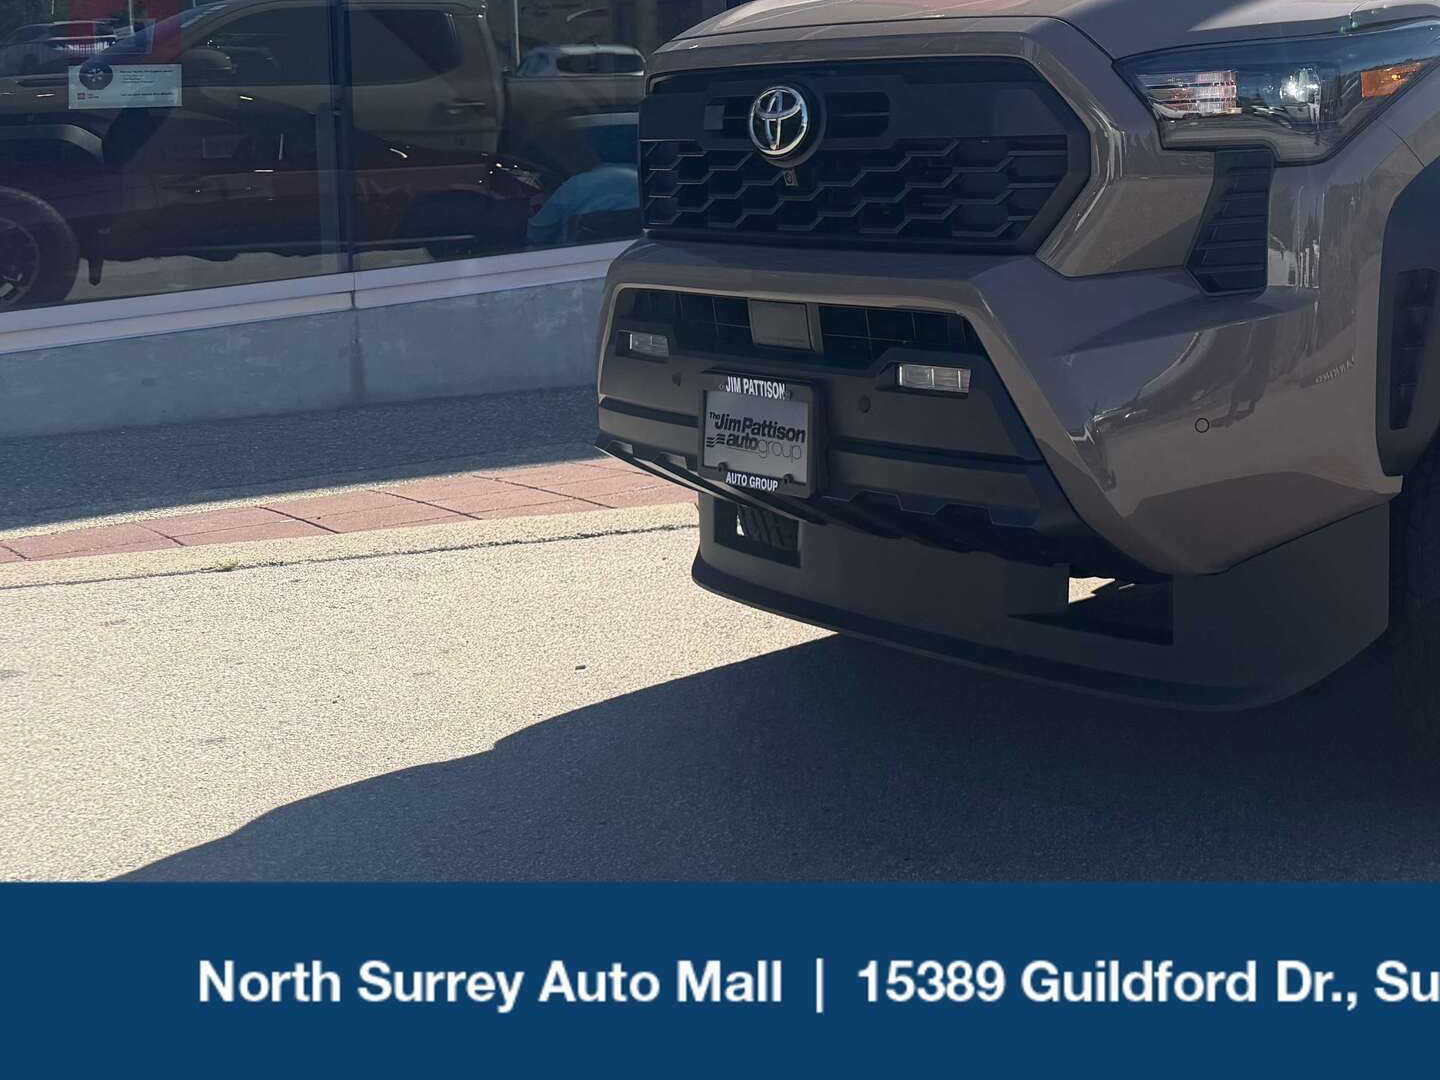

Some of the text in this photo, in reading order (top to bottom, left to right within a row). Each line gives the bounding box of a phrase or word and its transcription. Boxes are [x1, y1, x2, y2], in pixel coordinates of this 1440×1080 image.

[725, 376, 786, 400] JIM PATTISON
[725, 471, 779, 492] AUTO GROUP
